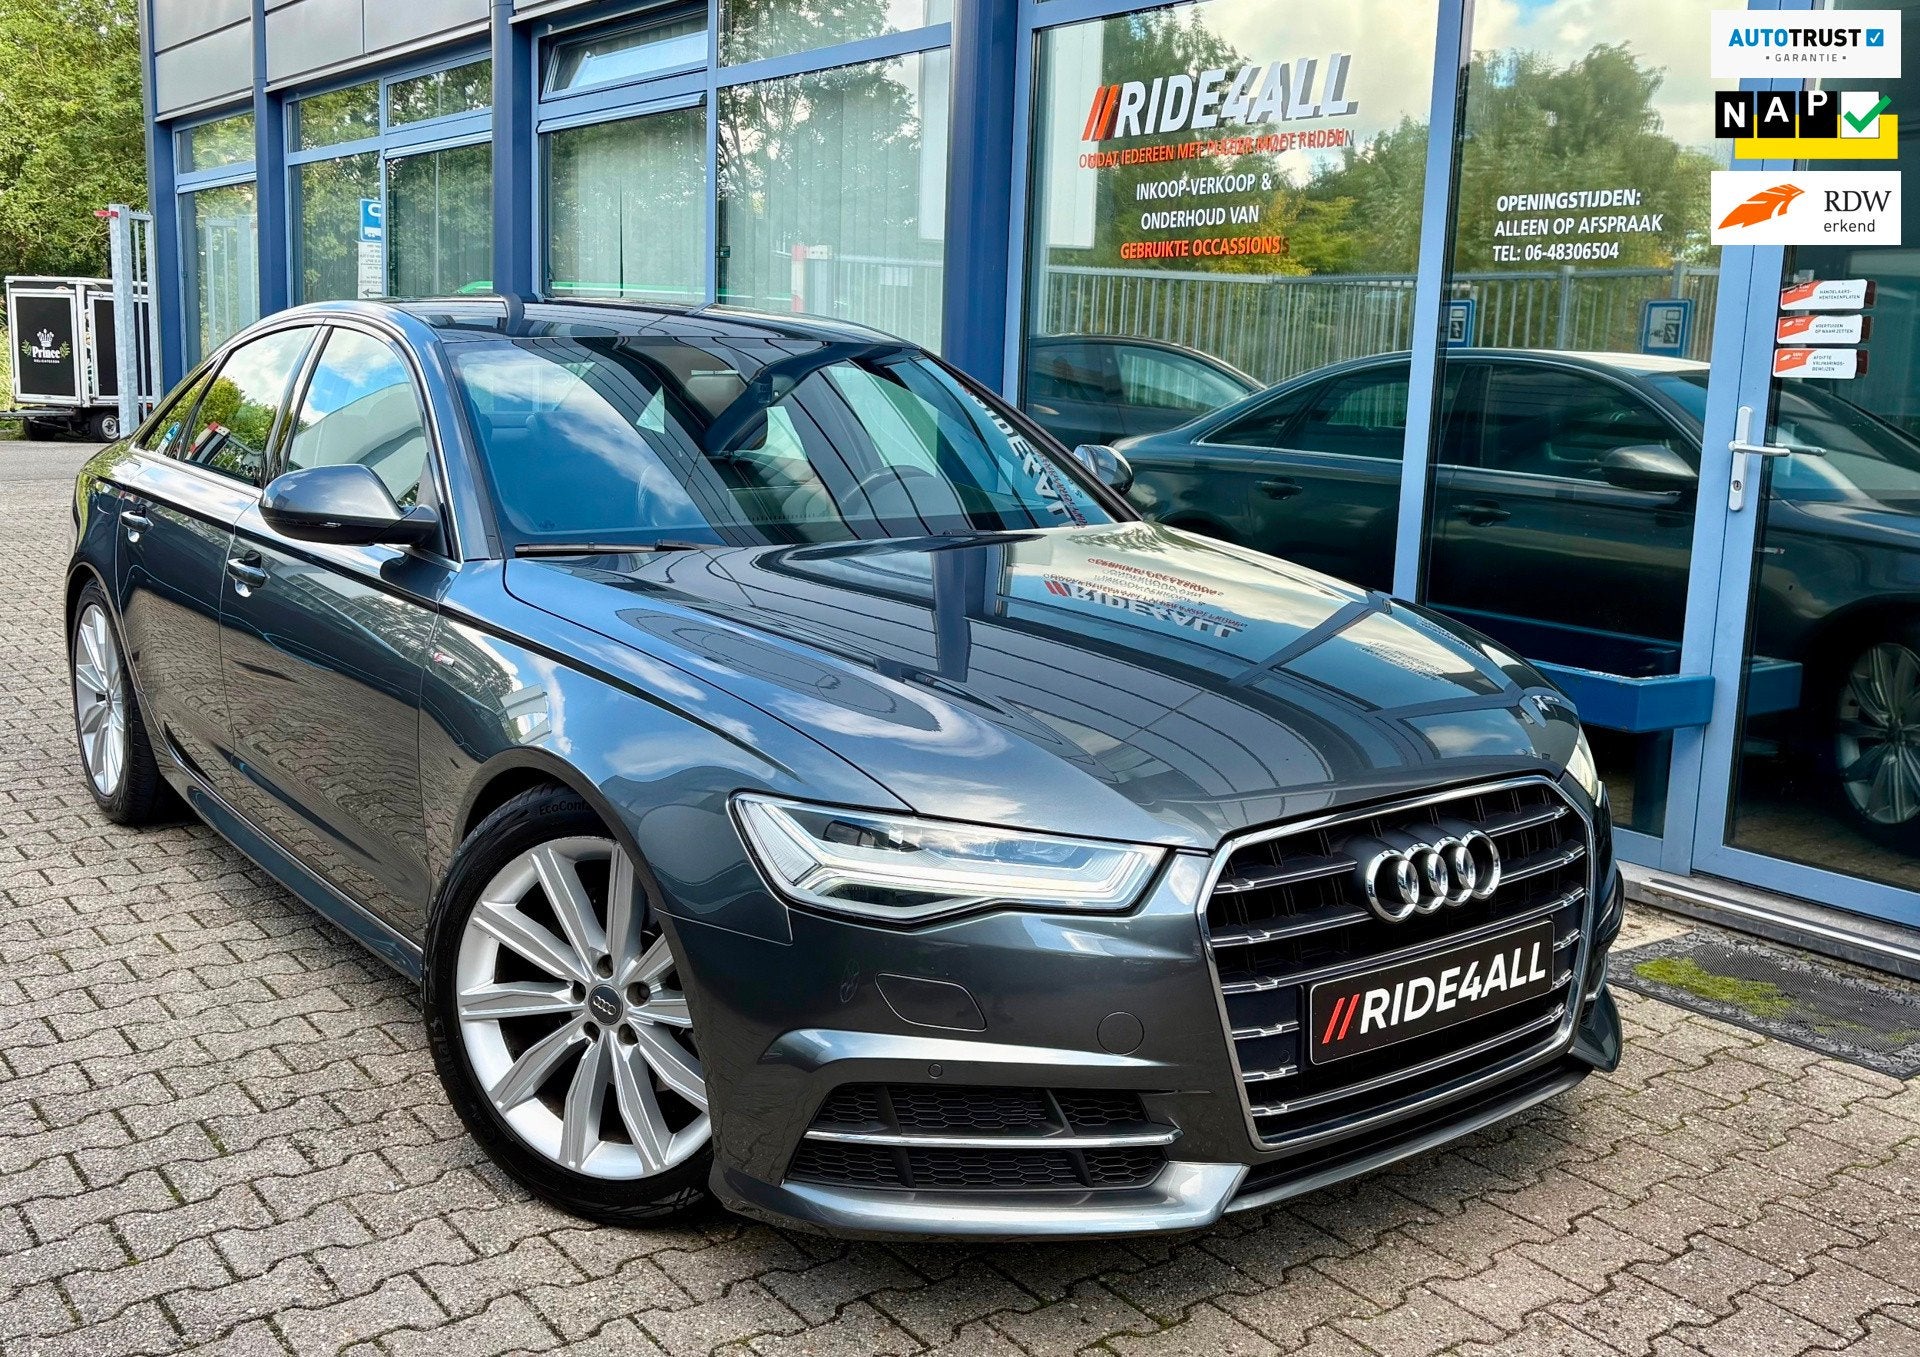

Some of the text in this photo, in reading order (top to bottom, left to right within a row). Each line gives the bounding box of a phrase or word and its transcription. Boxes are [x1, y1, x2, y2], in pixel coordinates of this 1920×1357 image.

[1121, 141, 1175, 165] IEDEREEN
[1136, 172, 1273, 201] INKOOP-VERKOOP &
[1496, 188, 1641, 212] OPENINGSTIJDEN:
[1141, 205, 1259, 230] ONDERHOUD VAN
[1494, 213, 1664, 237] ALLEEN OP AFSPRAAK
[1120, 236, 1282, 259] GEBRUIKTE OCCASSIONS
[1493, 241, 1619, 262] TEL: 06-48306504
[32, 345, 60, 359] Prince
